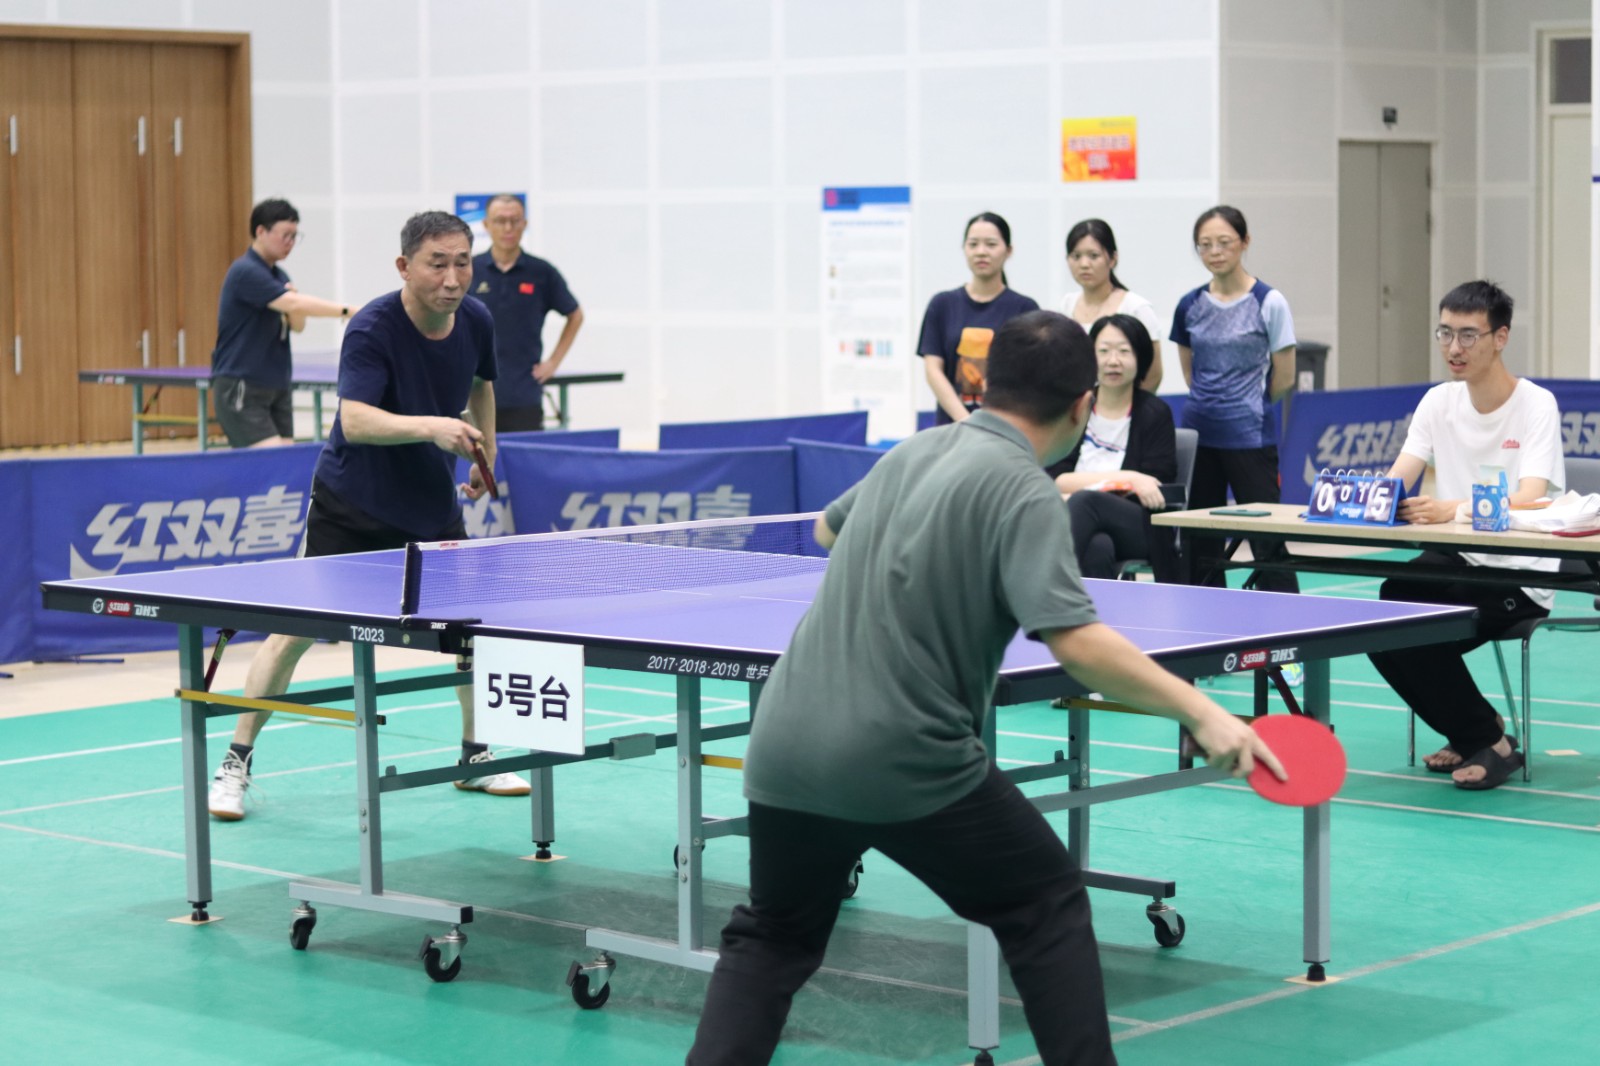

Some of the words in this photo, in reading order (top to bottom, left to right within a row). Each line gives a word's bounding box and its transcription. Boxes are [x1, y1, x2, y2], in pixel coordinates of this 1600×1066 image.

[1316, 483, 1333, 512] 0
[1340, 485, 1351, 502] 0
[1371, 487, 1389, 516] 5
[86, 484, 305, 564] 红双喜
[134, 604, 160, 617] DHS
[350, 625, 385, 643] T2023
[1270, 647, 1298, 663] DHS
[746, 663, 775, 680] 世乒
[487, 672, 571, 722] 5号台
